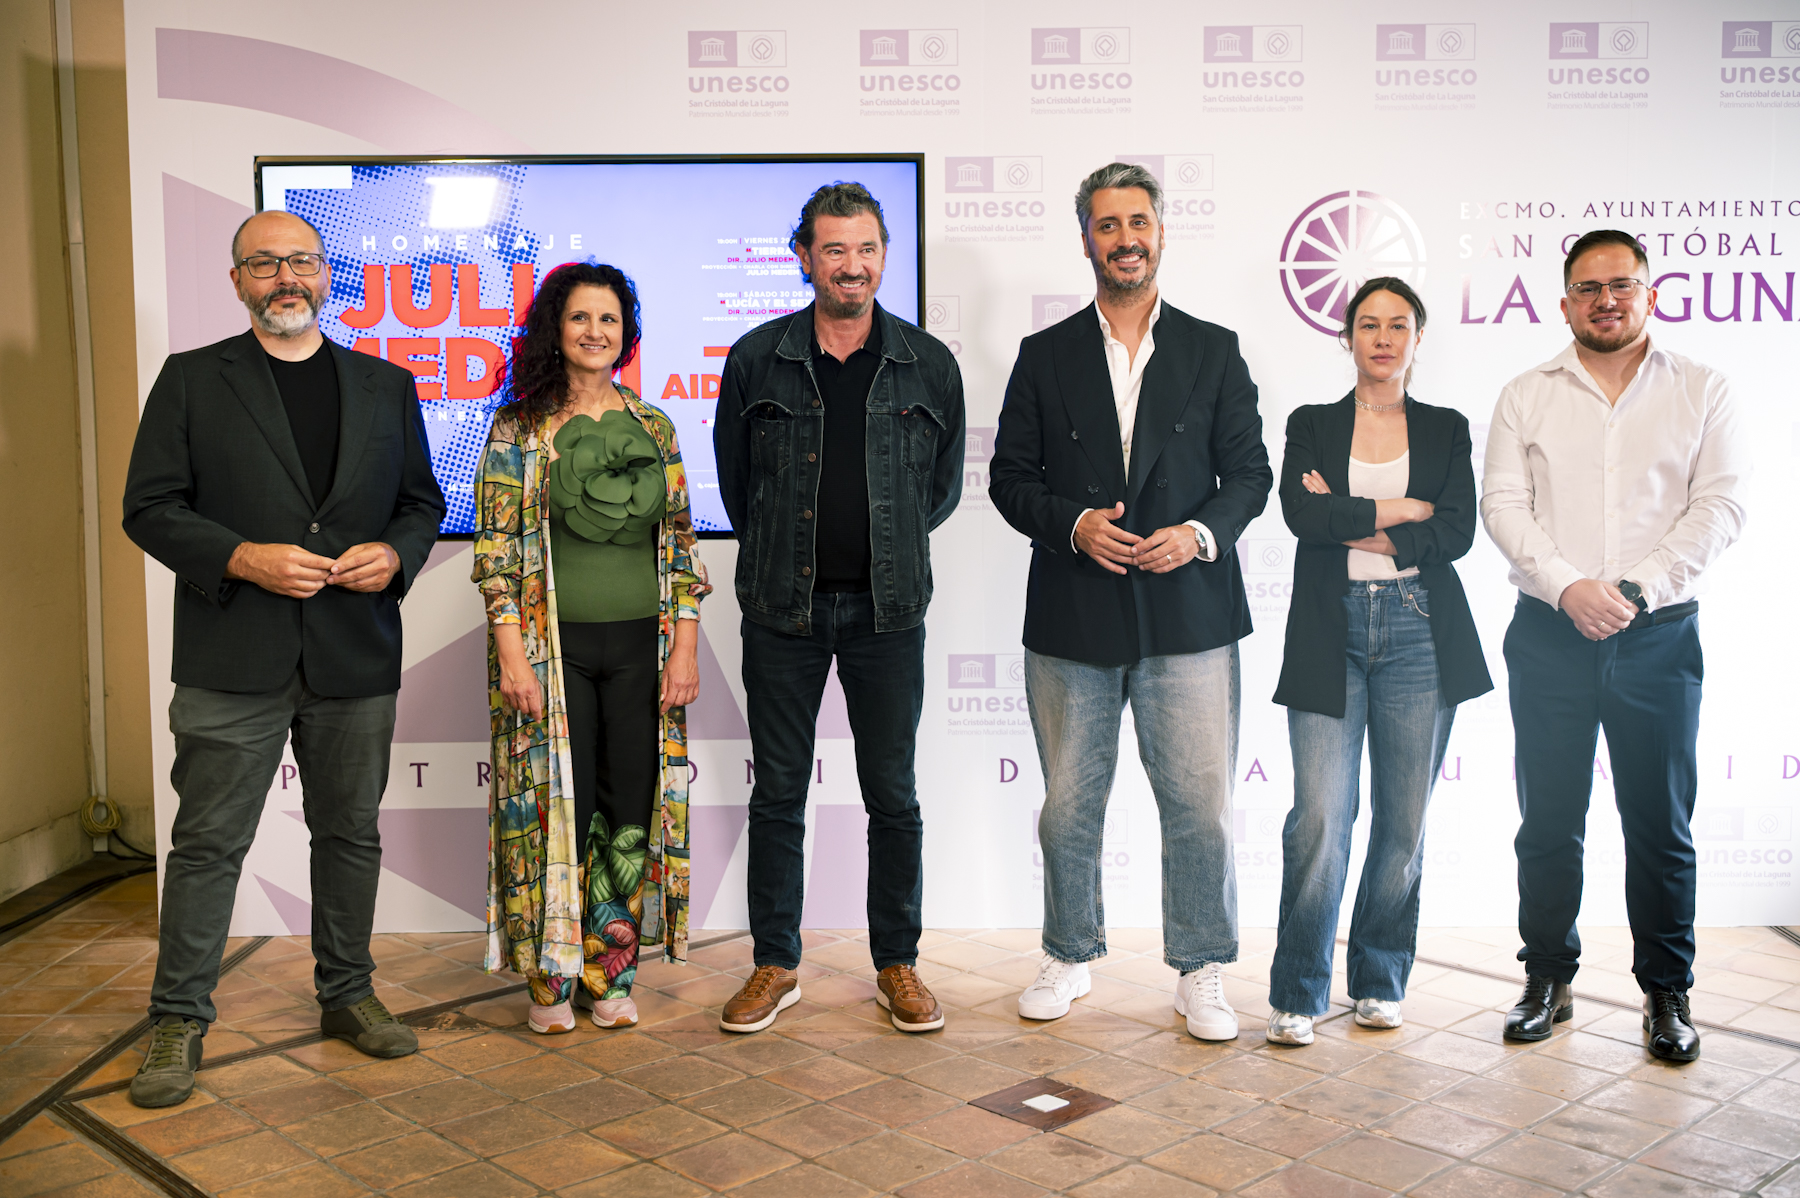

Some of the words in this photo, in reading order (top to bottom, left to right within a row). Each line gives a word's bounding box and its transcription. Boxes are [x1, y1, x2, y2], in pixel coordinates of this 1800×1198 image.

[860, 74, 961, 92] unesco
[1031, 72, 1132, 90] unesco
[1203, 70, 1304, 88] unesco
[1376, 68, 1477, 86] unesco
[1548, 67, 1650, 84] unesco
[1721, 66, 1800, 84] unesc
[688, 76, 790, 93] unesco
[860, 98, 875, 106] San
[876, 98, 908, 106] Cristóbal
[909, 98, 919, 106] de
[920, 98, 929, 106] La
[930, 98, 960, 108] Laguna
[1031, 96, 1046, 104] San
[1047, 96, 1080, 104] Cristóbal
[1081, 96, 1091, 104] de
[1092, 96, 1101, 104] La
[1102, 96, 1131, 106] Laguna
[1202, 94, 1218, 102] San
[1219, 94, 1251, 102] Cristóbal
[1253, 94, 1263, 102] de
[1264, 94, 1272, 102] La
[1274, 94, 1303, 104] Laguna
[1375, 92, 1390, 100] San
[1391, 92, 1424, 100] Cristóbal
[1425, 92, 1435, 100] de
[1436, 92, 1445, 100] La
[1446, 92, 1476, 102] Laguna
[1548, 90, 1562, 99] San
[1564, 90, 1596, 99] Cristóbal
[1598, 90, 1608, 99] de
[1609, 90, 1618, 99] La
[1619, 90, 1648, 100] Laguna
[688, 99, 703, 108] San
[705, 99, 737, 108] Cristóbal
[739, 99, 749, 108] de
[750, 99, 758, 108] La
[760, 99, 789, 109] Laguna
[945, 199, 1045, 218] unesco
[1460, 202, 1566, 220] EXCMO.
[1583, 200, 1800, 217] AYUNTAMIENTO
[945, 223, 960, 232] San
[961, 223, 993, 232] Cristóbal
[994, 223, 1004, 232] de
[1005, 223, 1014, 232] La
[1015, 223, 1044, 233] Laguna
[1186, 222, 1214, 232] Laguna
[362, 234, 582, 252] HOMENAJE
[1459, 234, 1534, 258] SAN
[1561, 226, 1783, 256] CSTÓBAL
[338, 263, 575, 328] JULI
[763, 299, 770, 307] Y
[773, 299, 787, 307] EL
[790, 299, 812, 307] SEX
[1460, 273, 1541, 324] LA
[660, 374, 722, 399] AID
[948, 696, 1028, 712] unesc
[1764, 871, 1791, 880] Laguna
